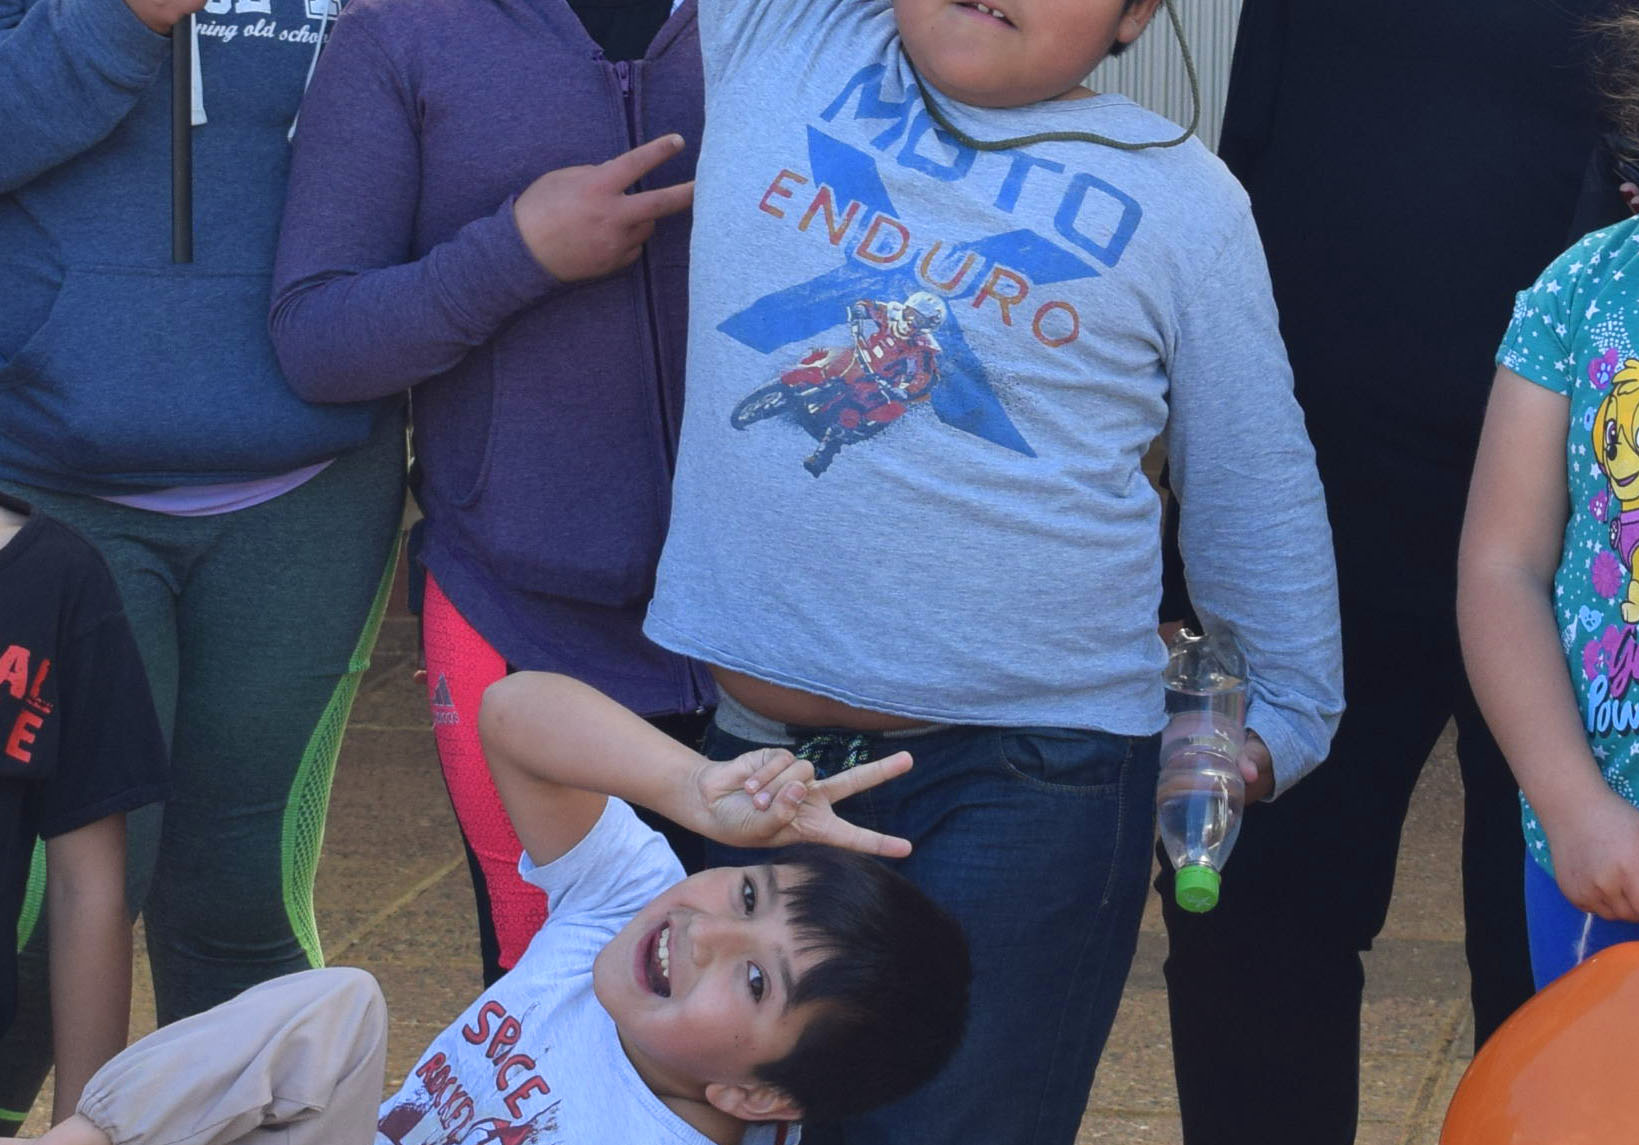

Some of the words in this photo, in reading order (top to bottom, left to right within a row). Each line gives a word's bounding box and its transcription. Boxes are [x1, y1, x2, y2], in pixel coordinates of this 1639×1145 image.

[243, 18, 277, 38] old
[819, 62, 1144, 269] MOTO
[759, 168, 1080, 348] ENDURO
